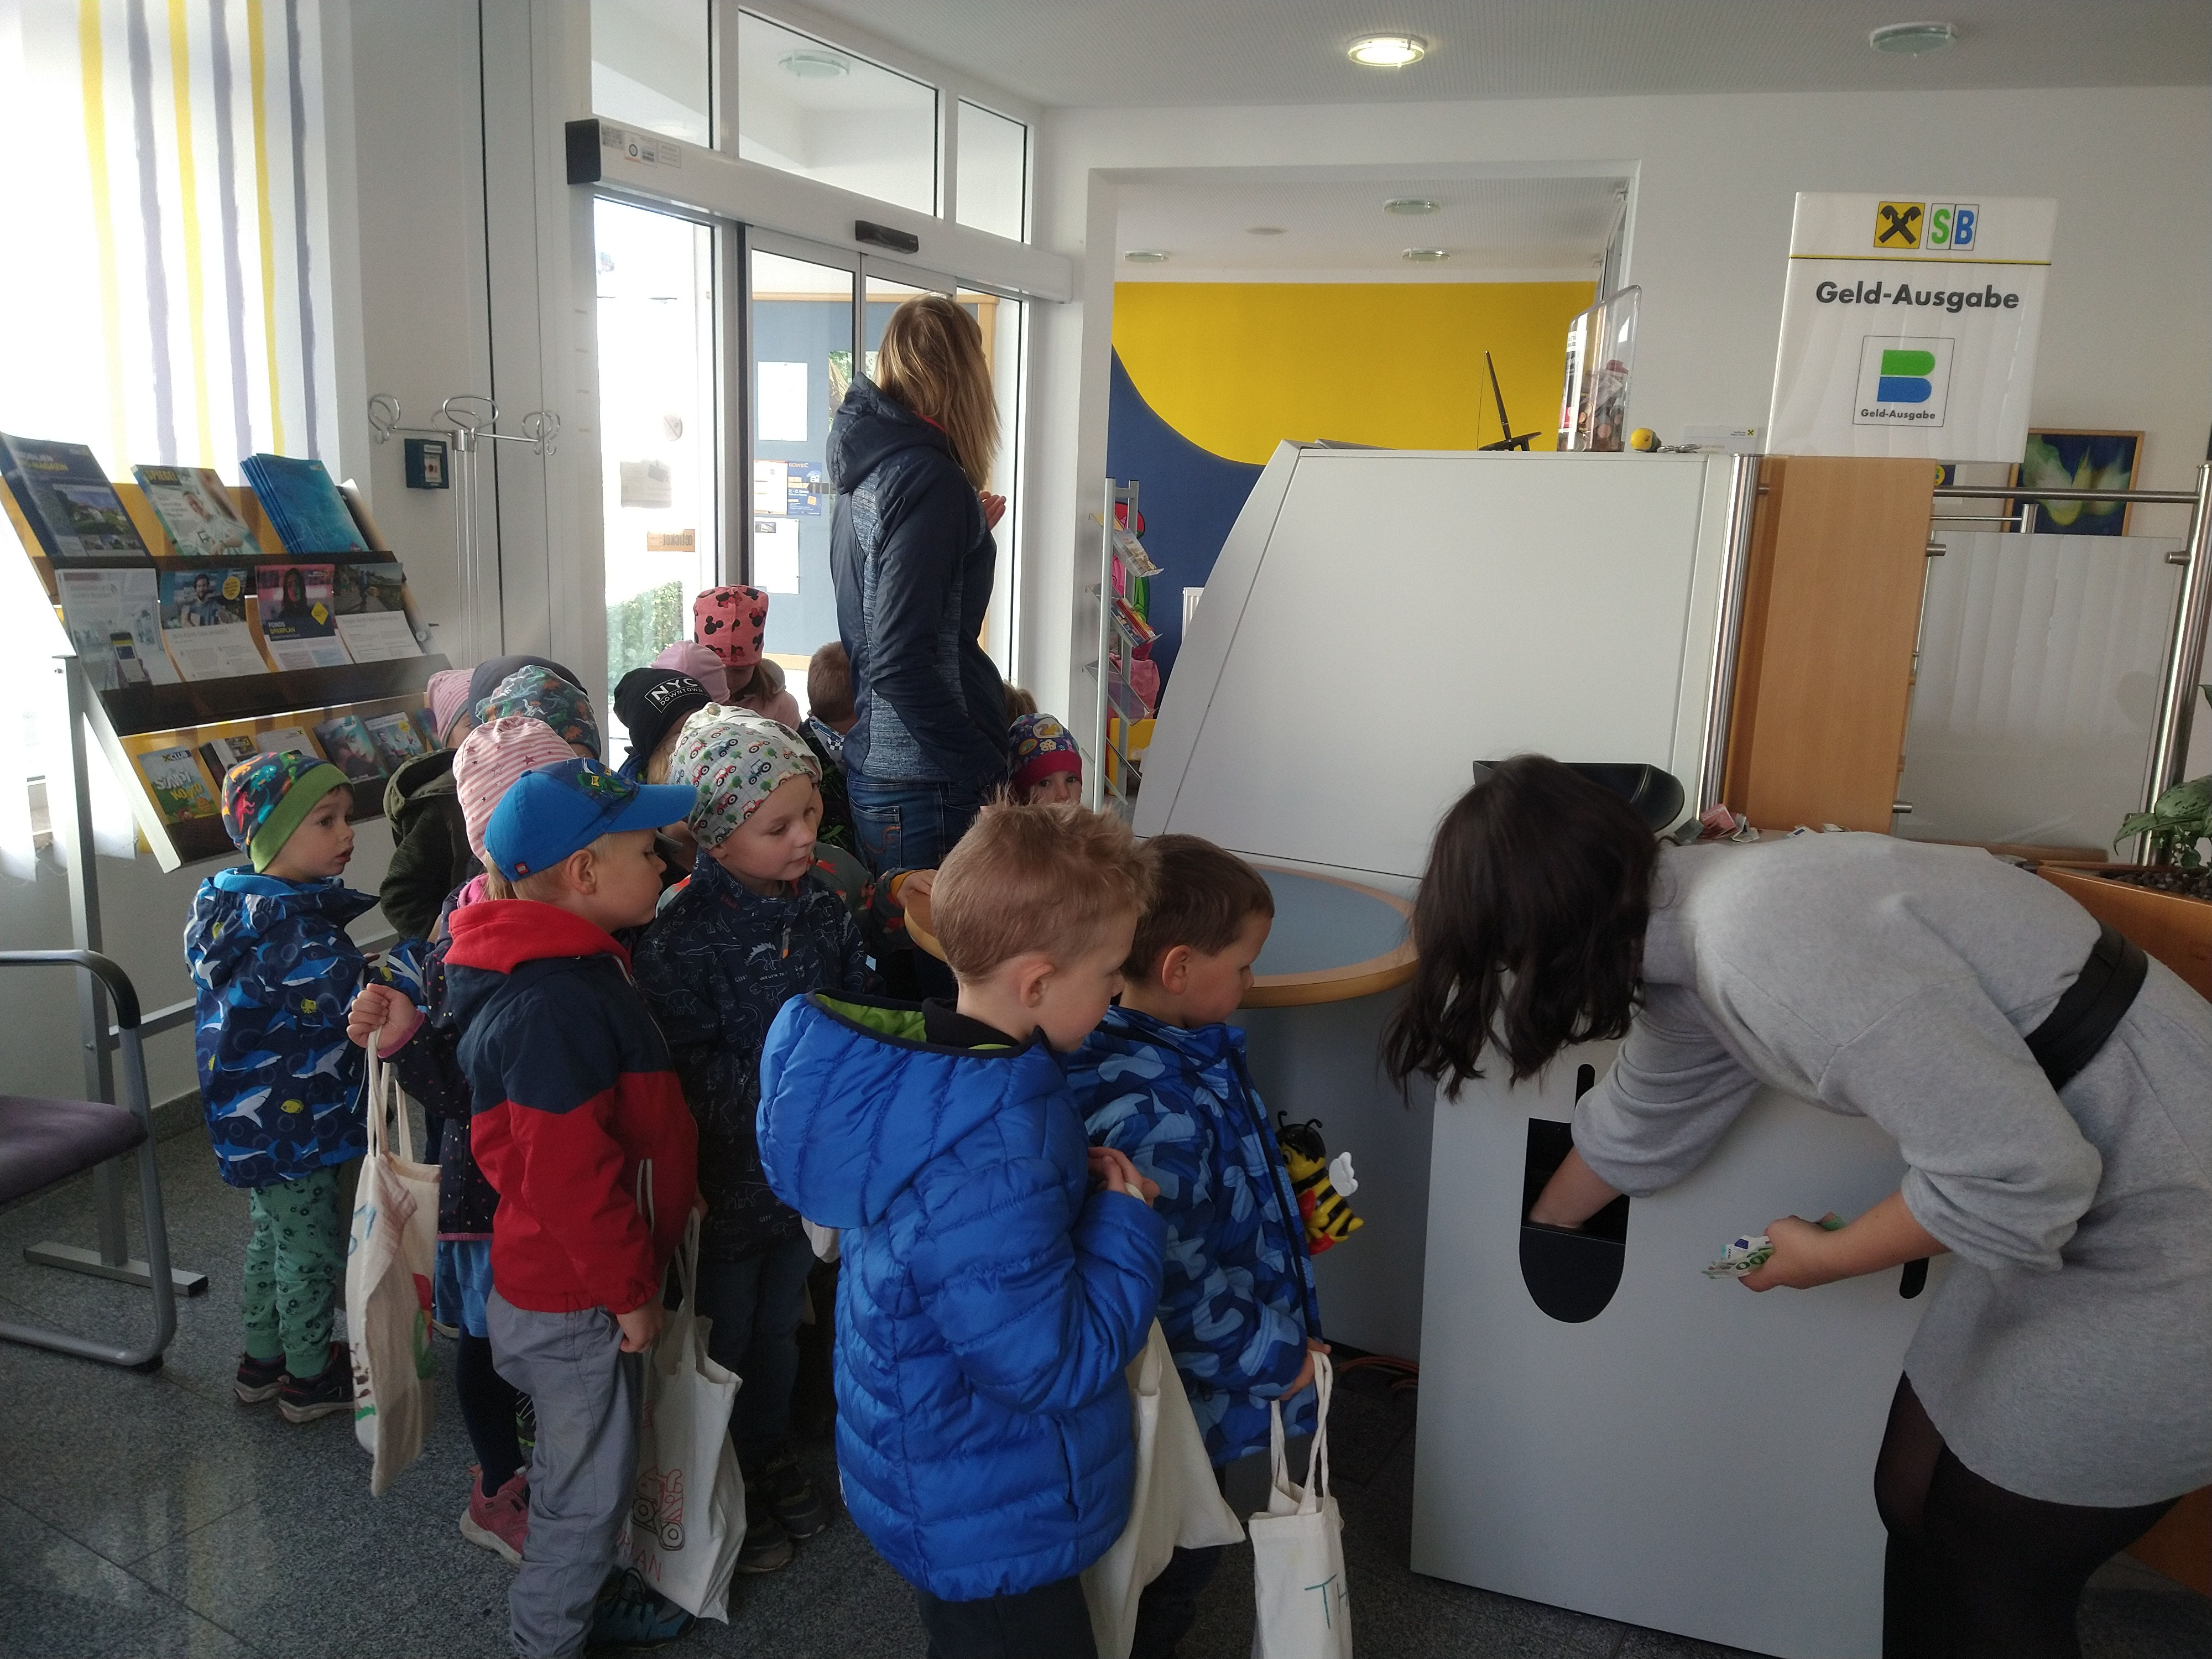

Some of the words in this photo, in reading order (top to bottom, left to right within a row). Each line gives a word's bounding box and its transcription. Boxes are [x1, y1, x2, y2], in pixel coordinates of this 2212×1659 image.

[1931, 208, 1975, 245] SB
[1815, 280, 2020, 313] Geld-Ausgabe
[1861, 408, 1936, 421] Geld-Ausgabe
[651, 678, 698, 701] NYC
[660, 687, 703, 706] DOWNTOWN
